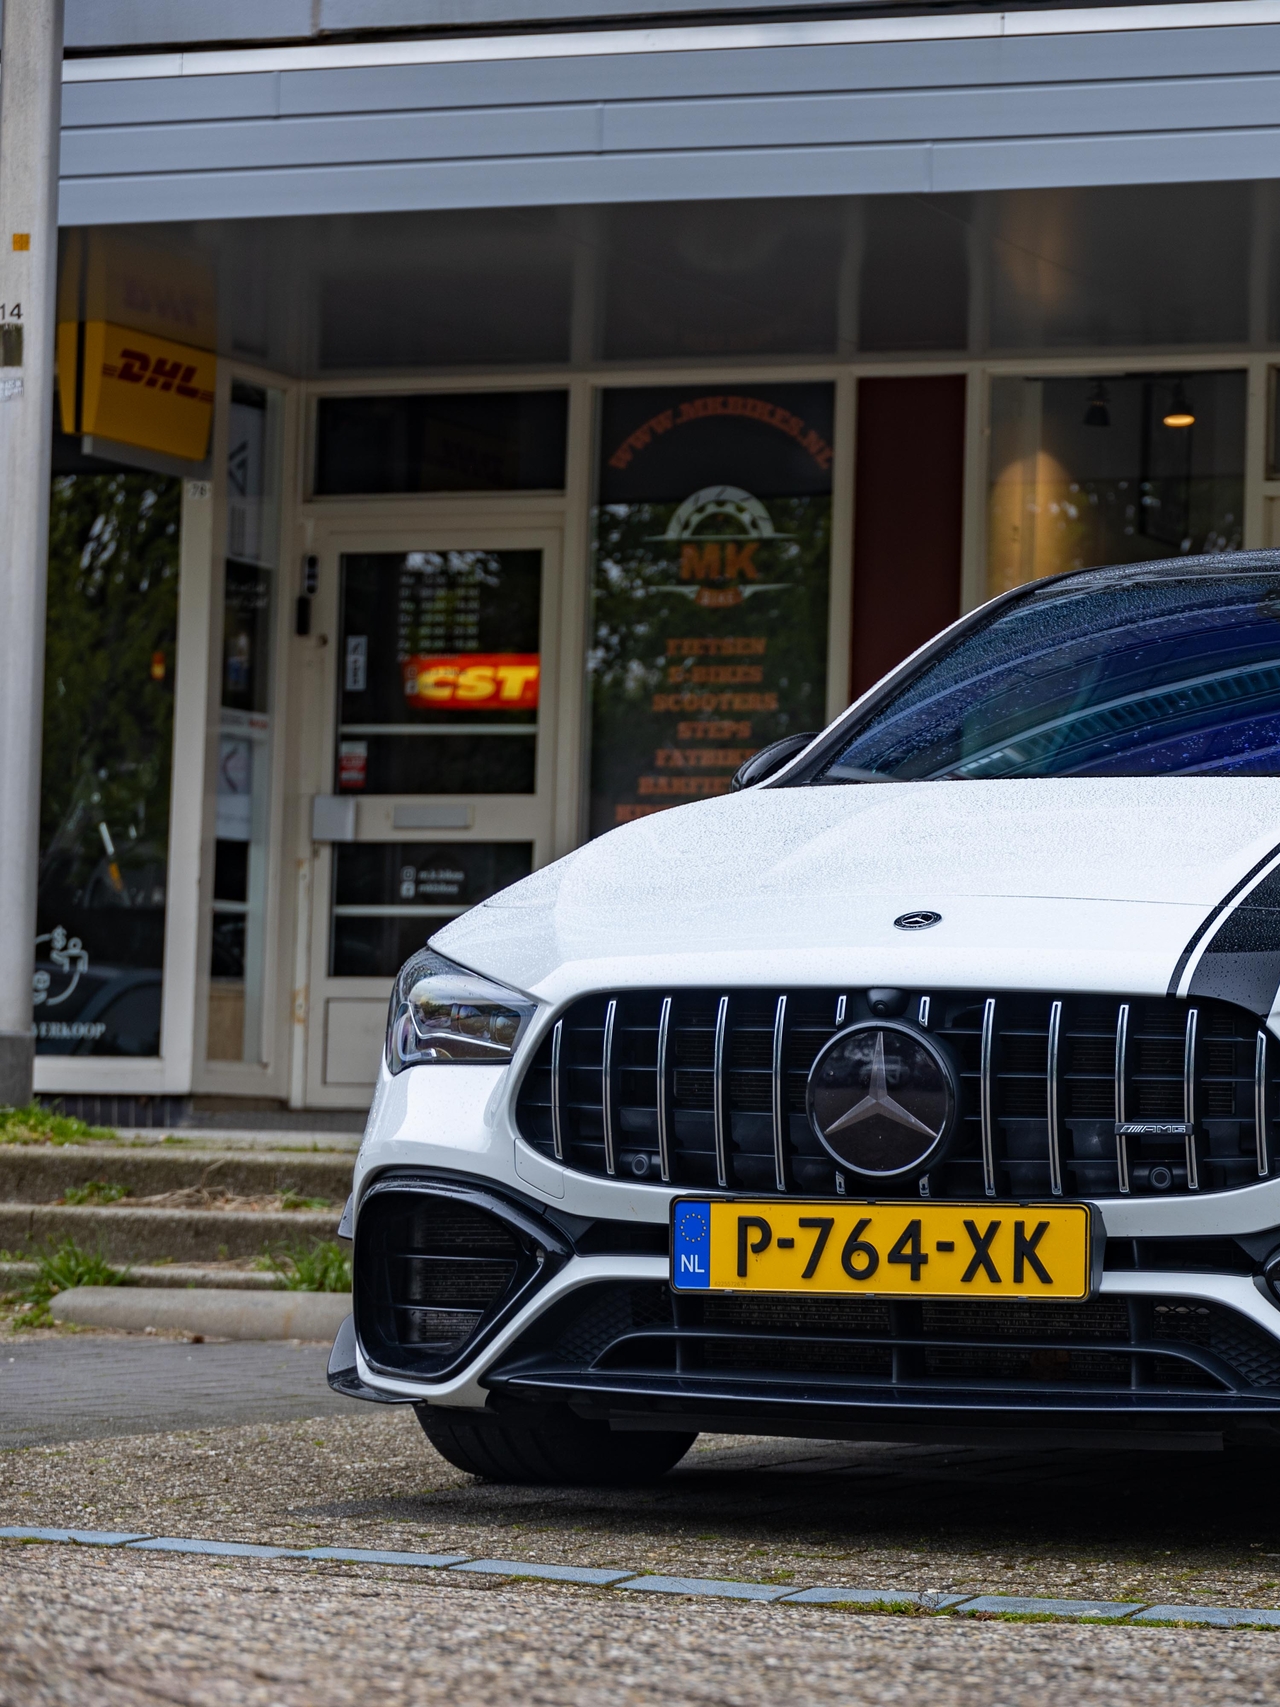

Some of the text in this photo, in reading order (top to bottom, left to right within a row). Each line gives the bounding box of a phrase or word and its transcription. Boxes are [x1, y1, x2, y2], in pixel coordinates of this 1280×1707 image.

[117, 349, 200, 398] DHL
[681, 542, 760, 580] MK
[416, 665, 541, 700] CST
[668, 665, 763, 683] E-BIKES
[652, 692, 779, 712] SCOOTERS
[677, 721, 752, 739] STEPS
[1138, 1125, 1186, 1133] AMG
[737, 1216, 1053, 1284] P-764-XK
[681, 1254, 705, 1273] NL
